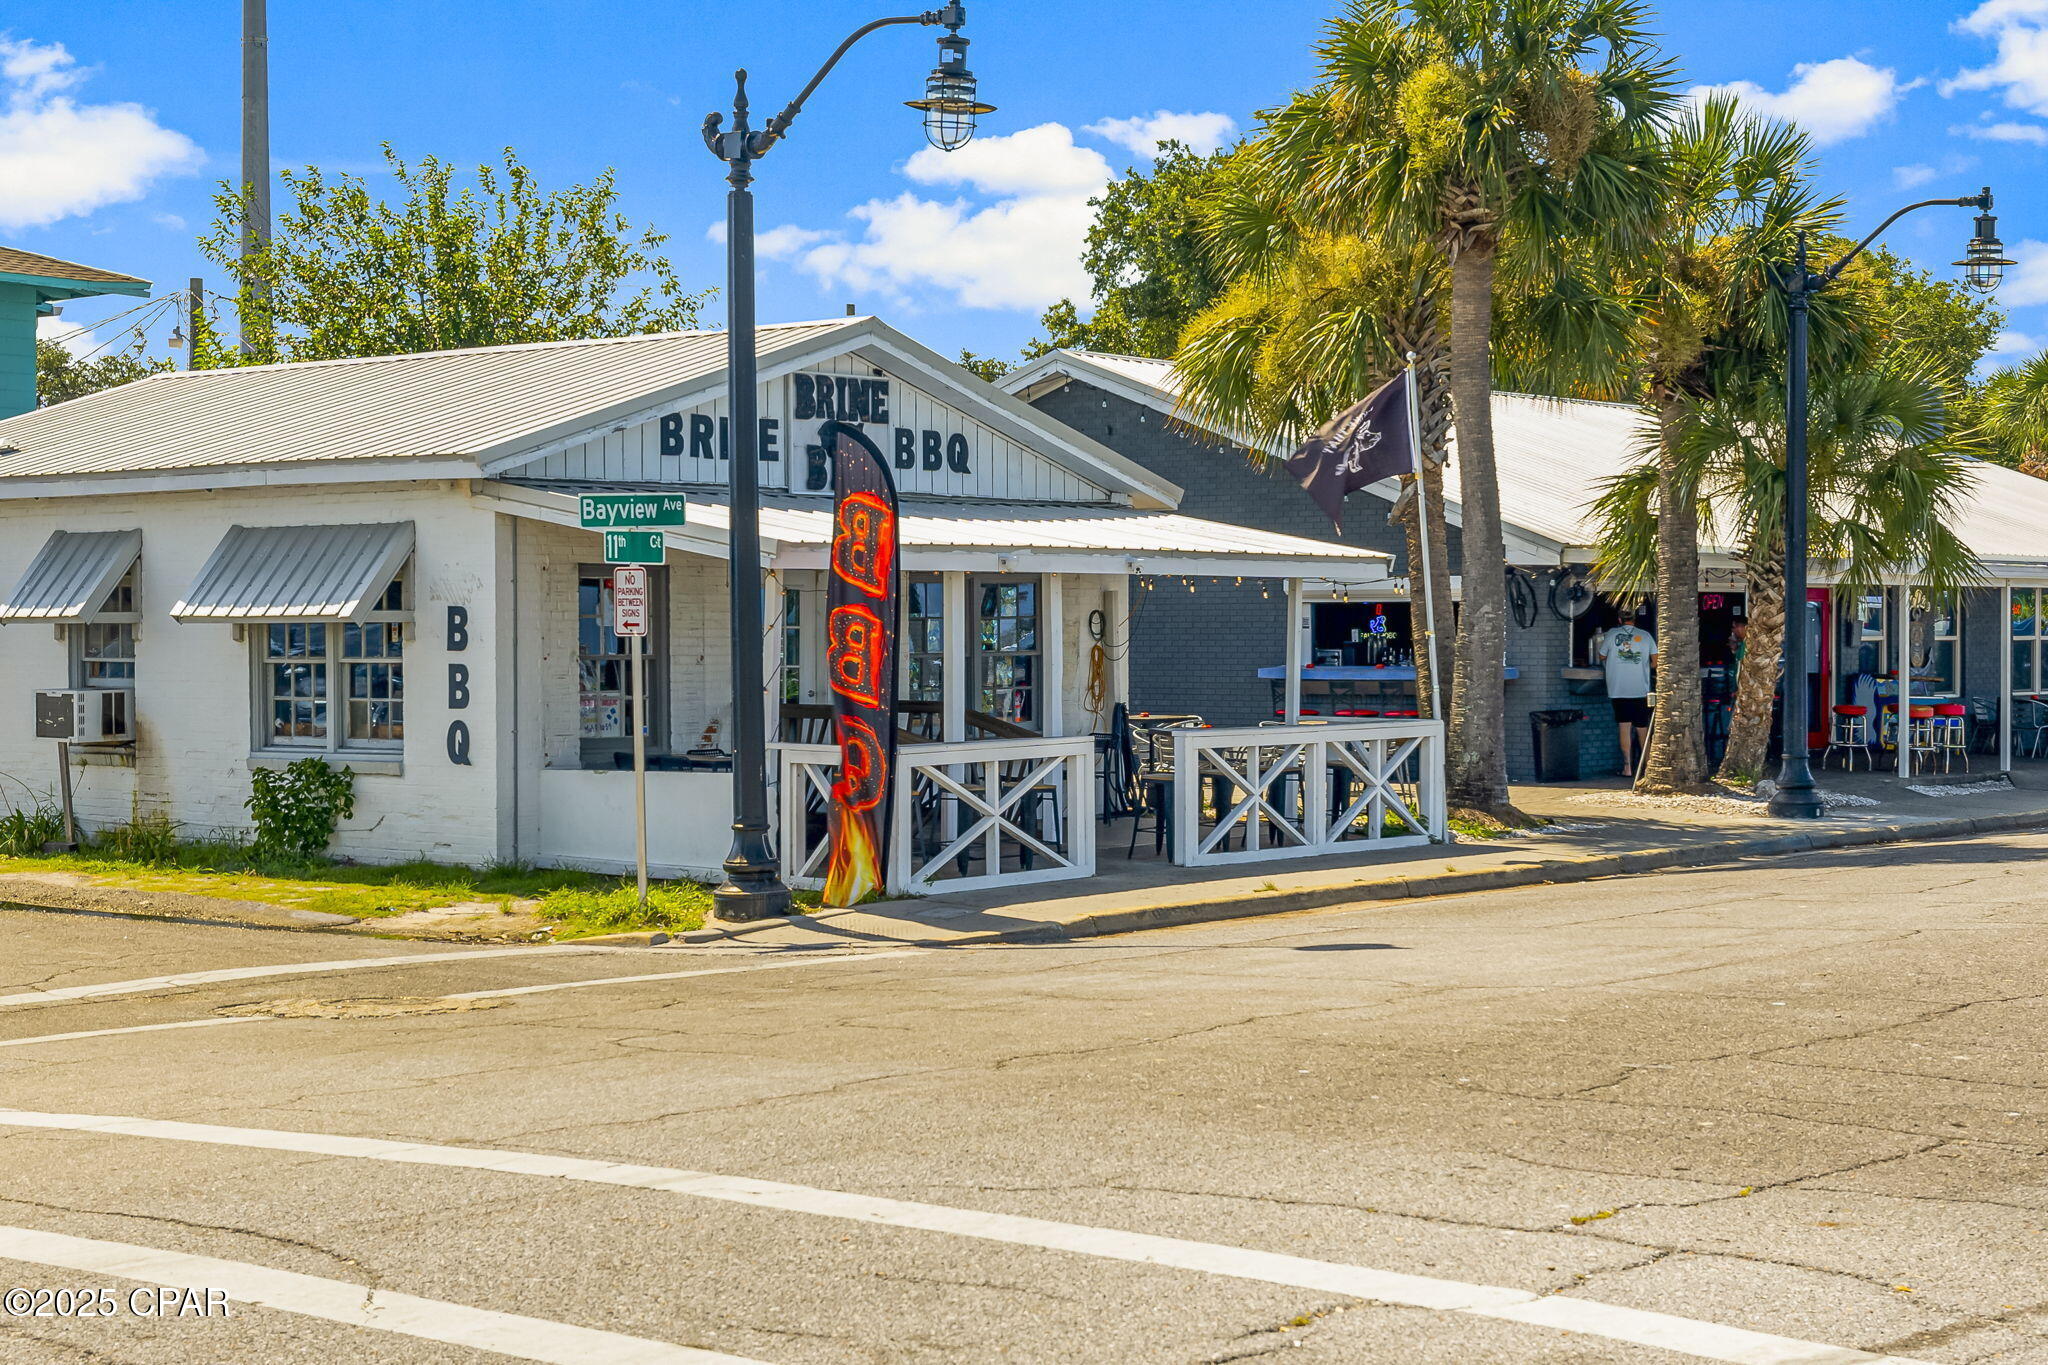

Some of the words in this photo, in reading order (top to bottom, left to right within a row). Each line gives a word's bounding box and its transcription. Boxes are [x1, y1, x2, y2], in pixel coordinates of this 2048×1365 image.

[795, 373, 889, 424] BRINE
[660, 412, 779, 461] BRIE
[895, 427, 971, 474] BBQ
[582, 498, 657, 526] Bayview
[662, 498, 682, 511] Ave
[606, 534, 627, 559] 11th
[650, 535, 662, 548] Ct
[617, 587, 644, 596] PARKING
[624, 574, 636, 585] NO
[617, 598, 644, 607] BETWEEN
[621, 608, 641, 618] SIGNS
[446, 605, 473, 767] BBQ
